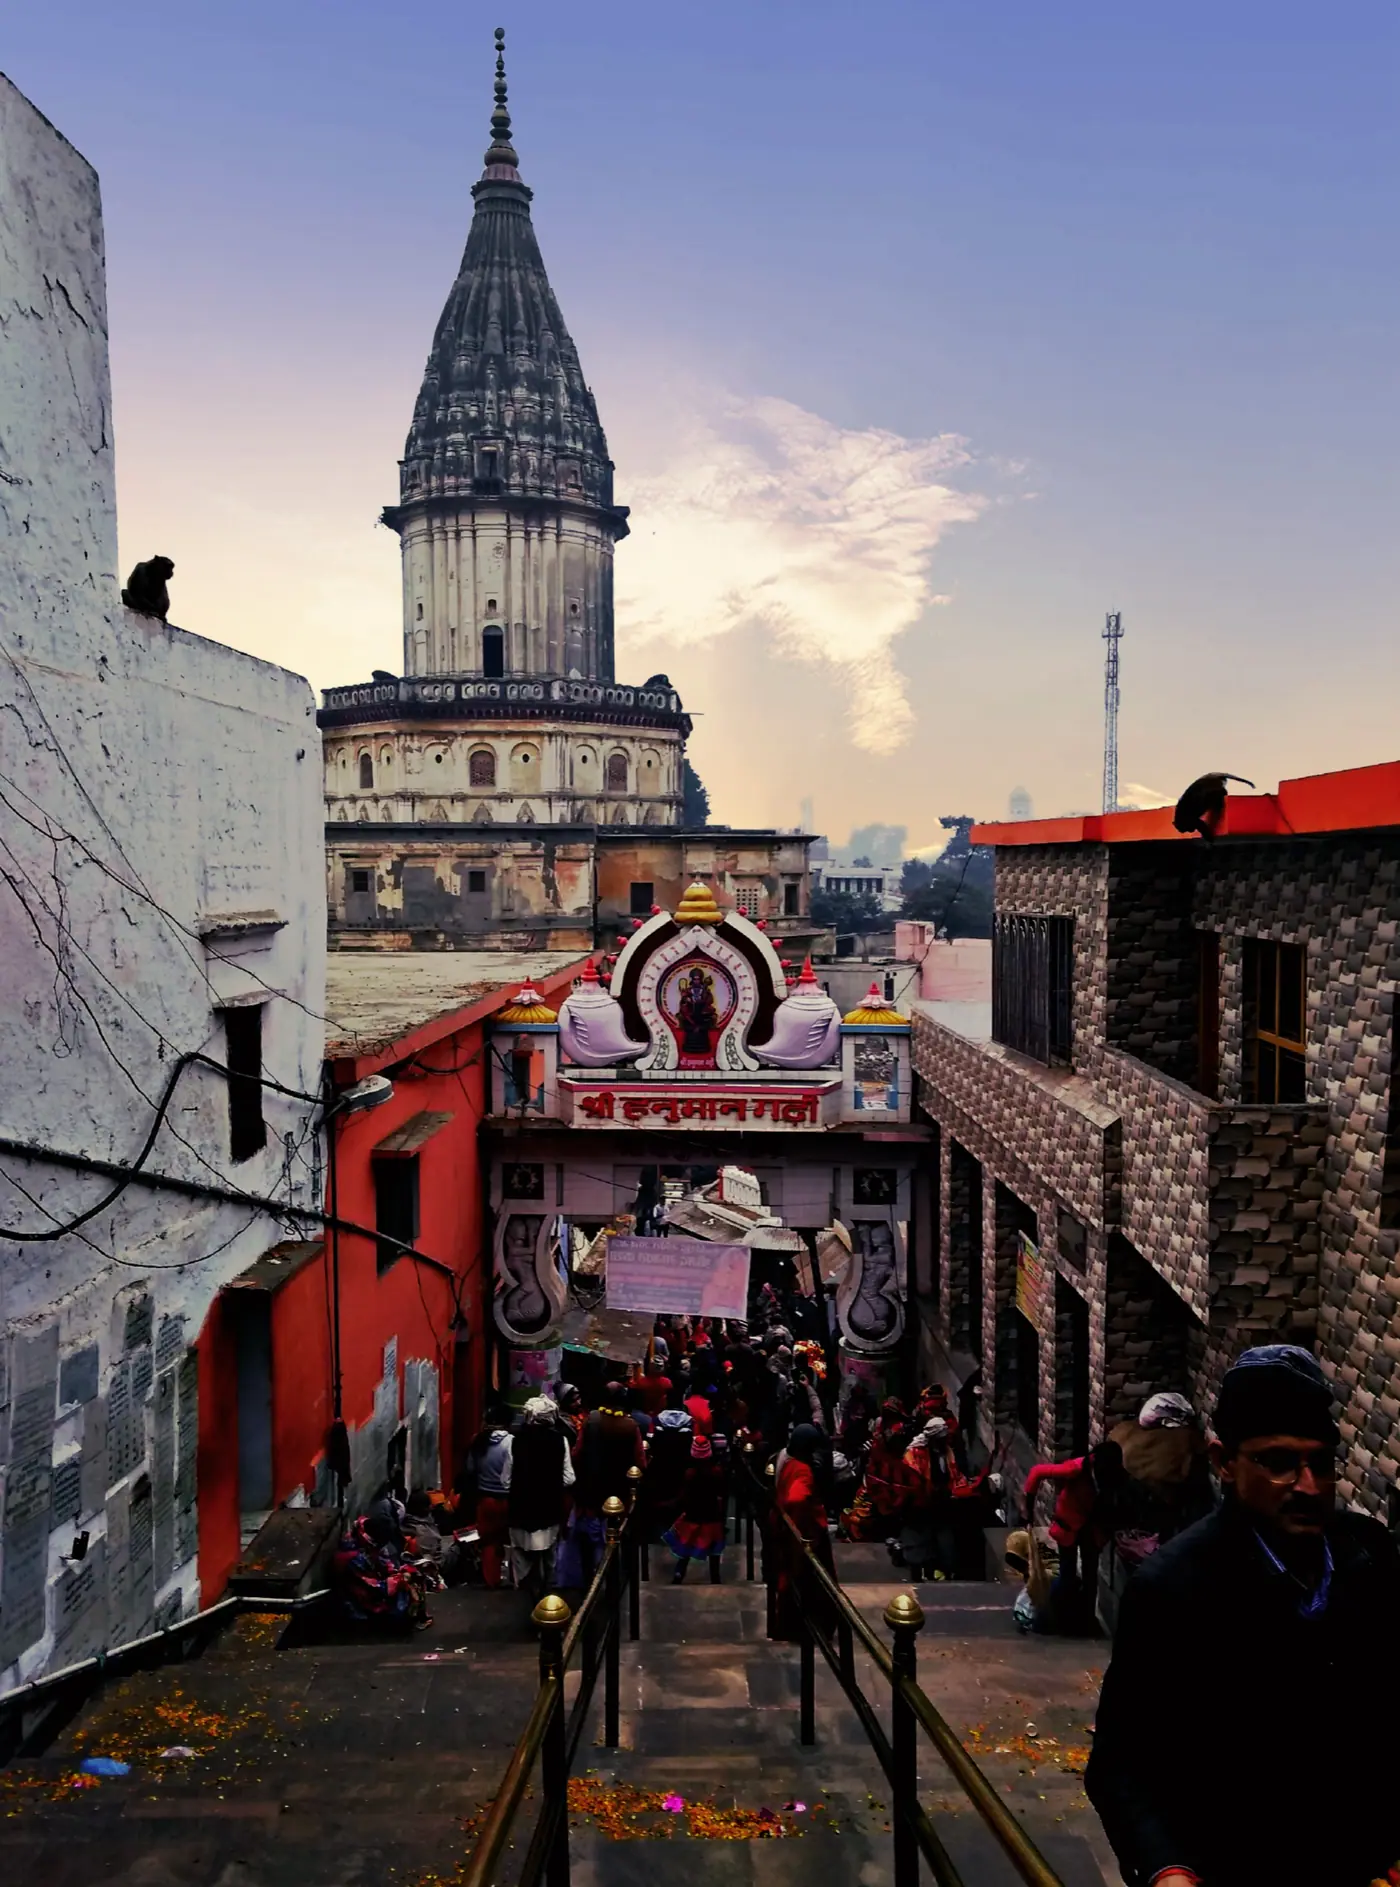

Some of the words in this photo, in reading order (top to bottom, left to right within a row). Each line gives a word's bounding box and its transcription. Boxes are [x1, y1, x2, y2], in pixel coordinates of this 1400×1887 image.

[580, 1092, 615, 1119] श्री
[618, 1097, 748, 1122] हनुमान
[751, 1094, 819, 1126] गढ़ी
